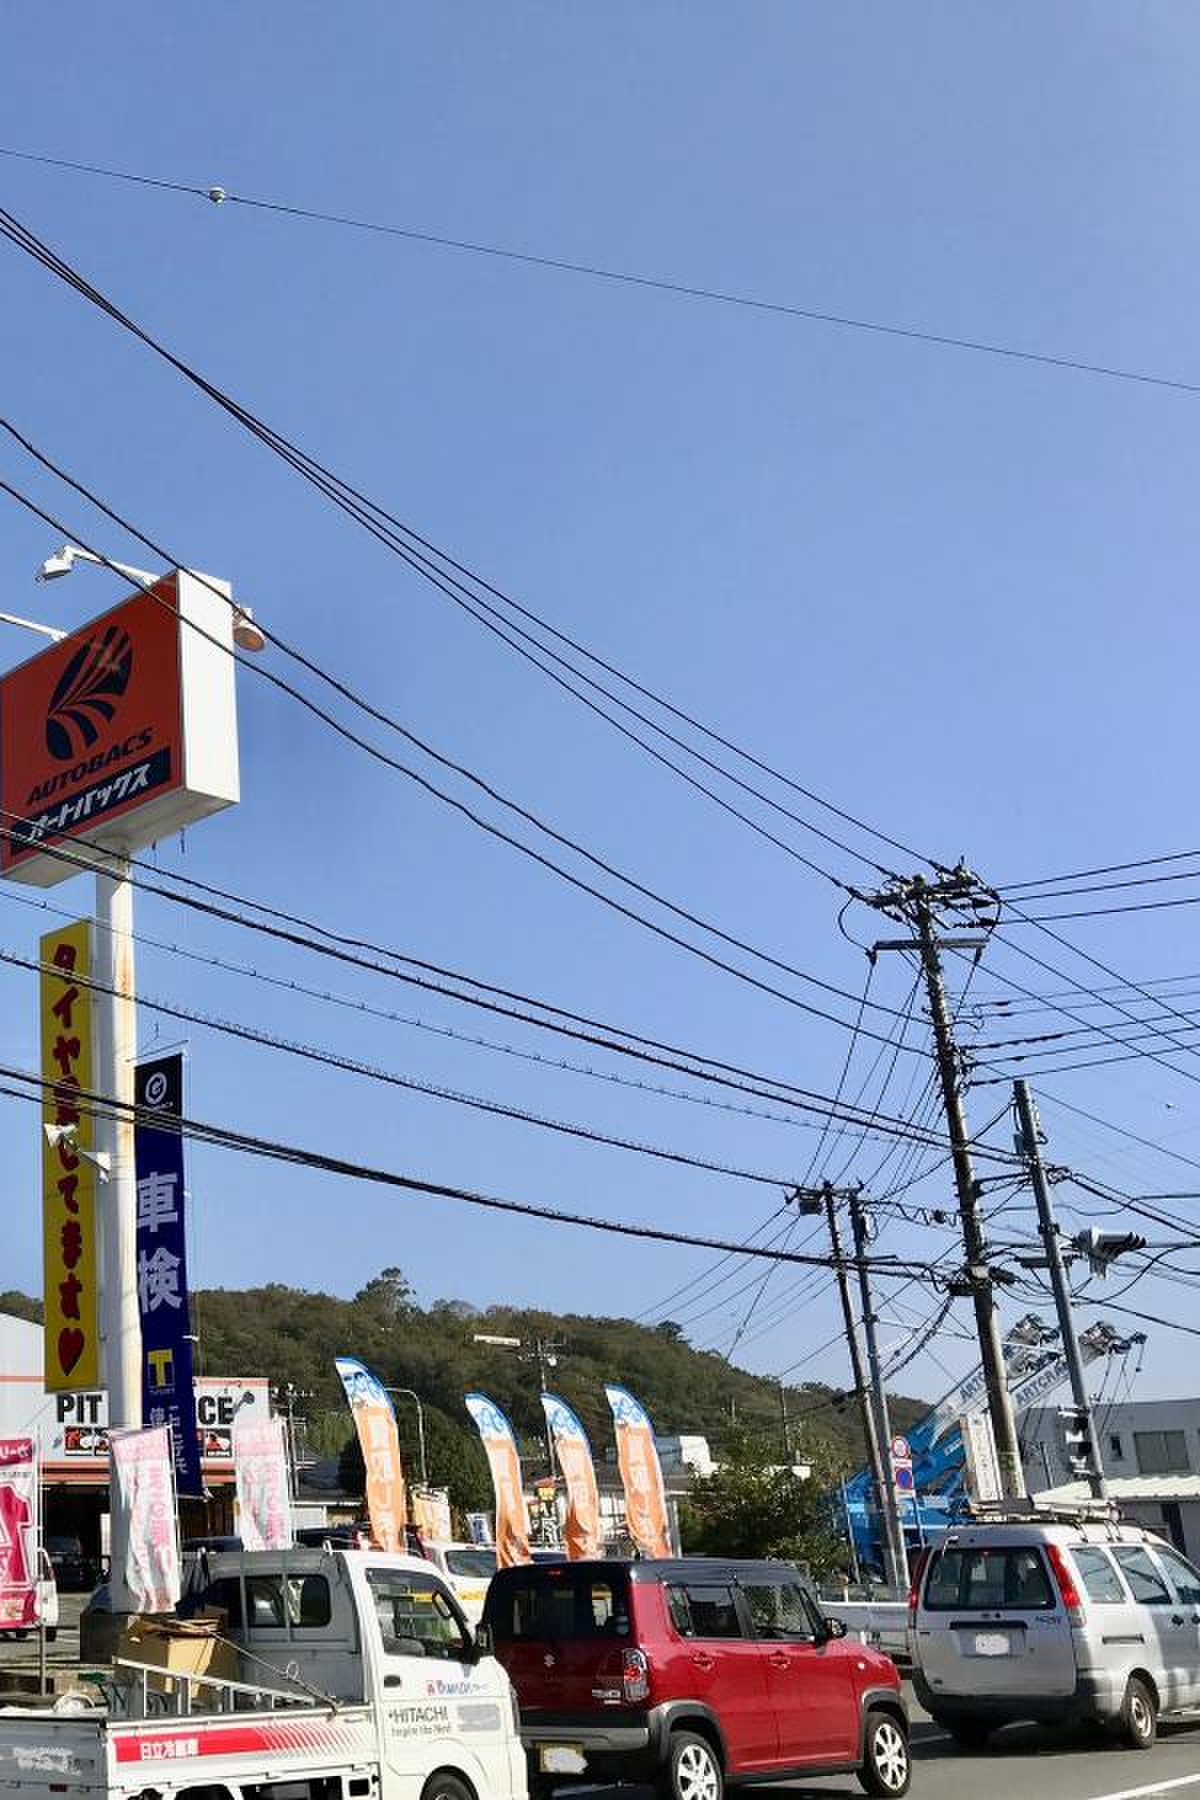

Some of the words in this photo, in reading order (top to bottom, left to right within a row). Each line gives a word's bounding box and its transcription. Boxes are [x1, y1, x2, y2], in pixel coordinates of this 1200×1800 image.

[26, 727, 156, 804] AUTOBACS
[29, 763, 151, 841] オートバックス
[137, 1171, 183, 1312] 車検
[57, 1394, 102, 1423] PIT
[394, 1705, 448, 1723] HITACHI
